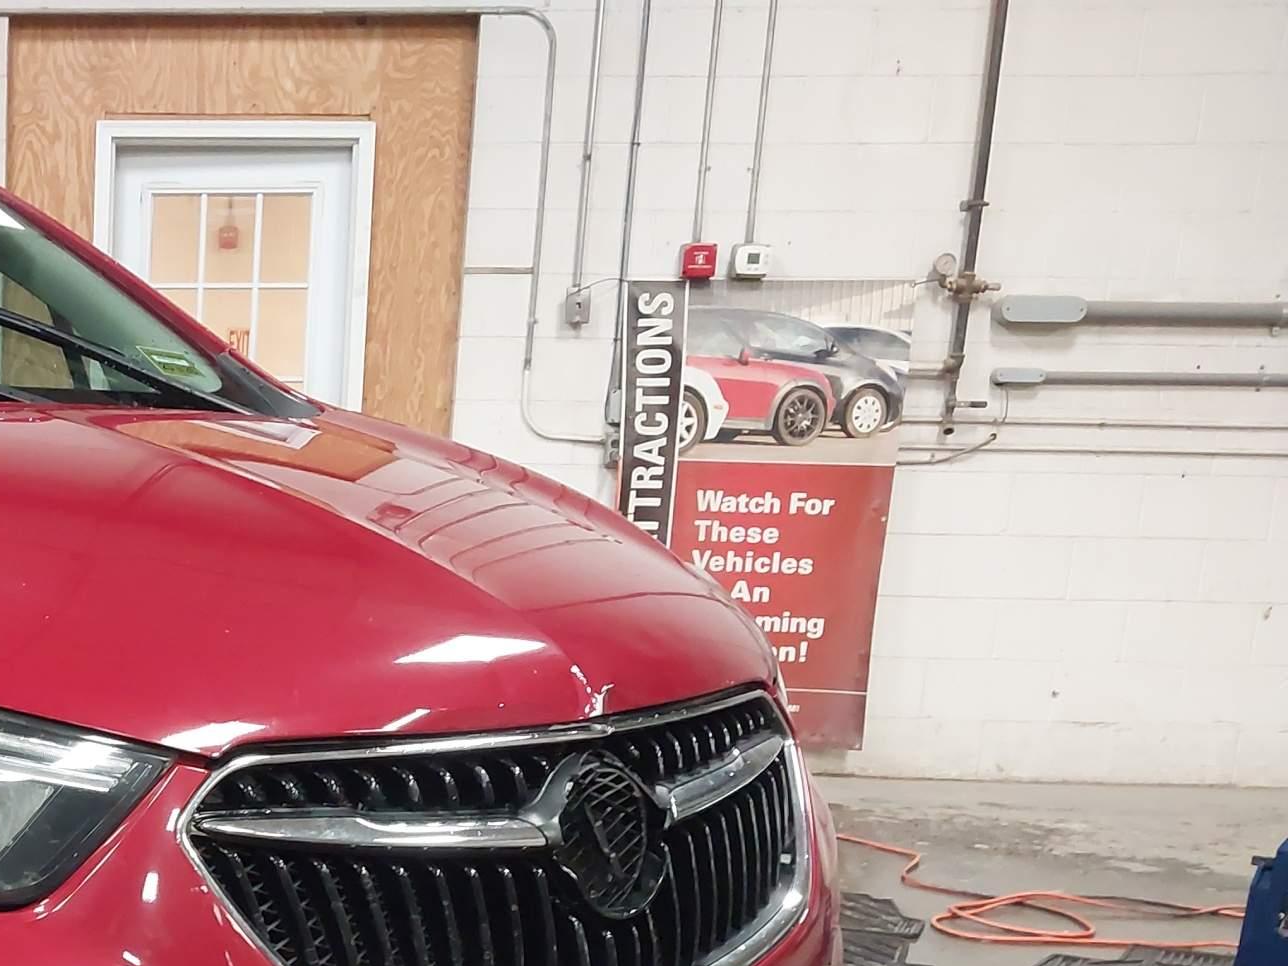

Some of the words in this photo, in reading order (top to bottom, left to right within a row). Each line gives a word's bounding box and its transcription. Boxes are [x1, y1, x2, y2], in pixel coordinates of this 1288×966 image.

[627, 292, 675, 539] TTRACTIONS
[696, 489, 781, 514] Watch
[789, 492, 835, 515] For
[694, 519, 779, 544] These
[692, 549, 814, 575] Vehicles
[730, 580, 770, 603] An
[755, 611, 825, 639] ming
